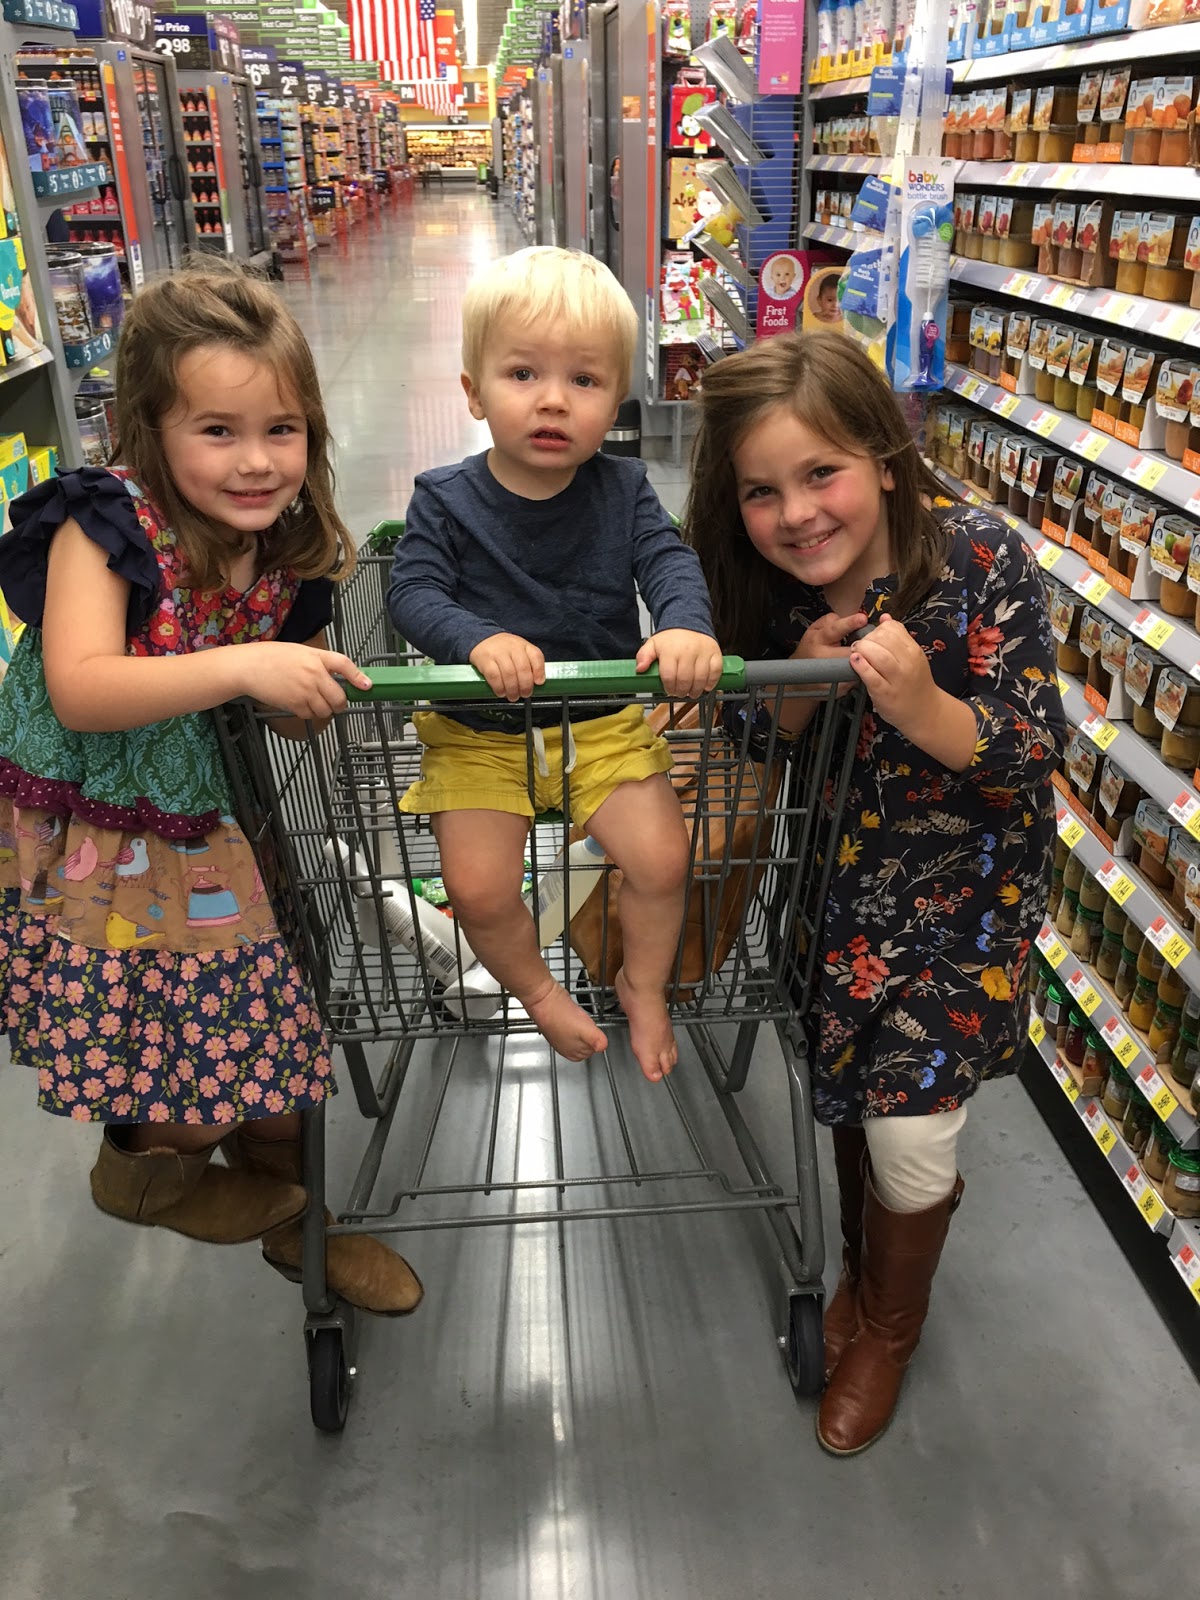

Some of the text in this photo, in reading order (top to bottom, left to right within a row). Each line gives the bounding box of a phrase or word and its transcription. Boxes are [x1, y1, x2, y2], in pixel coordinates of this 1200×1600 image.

[232, 11, 259, 20] Snacks
[166, 22, 190, 32] Price
[908, 170, 938, 185] baby
[908, 183, 945, 192] WONDERS
[907, 192, 948, 200] bottle brush
[766, 305, 787, 316] First
[763, 316, 788, 326] Foods
